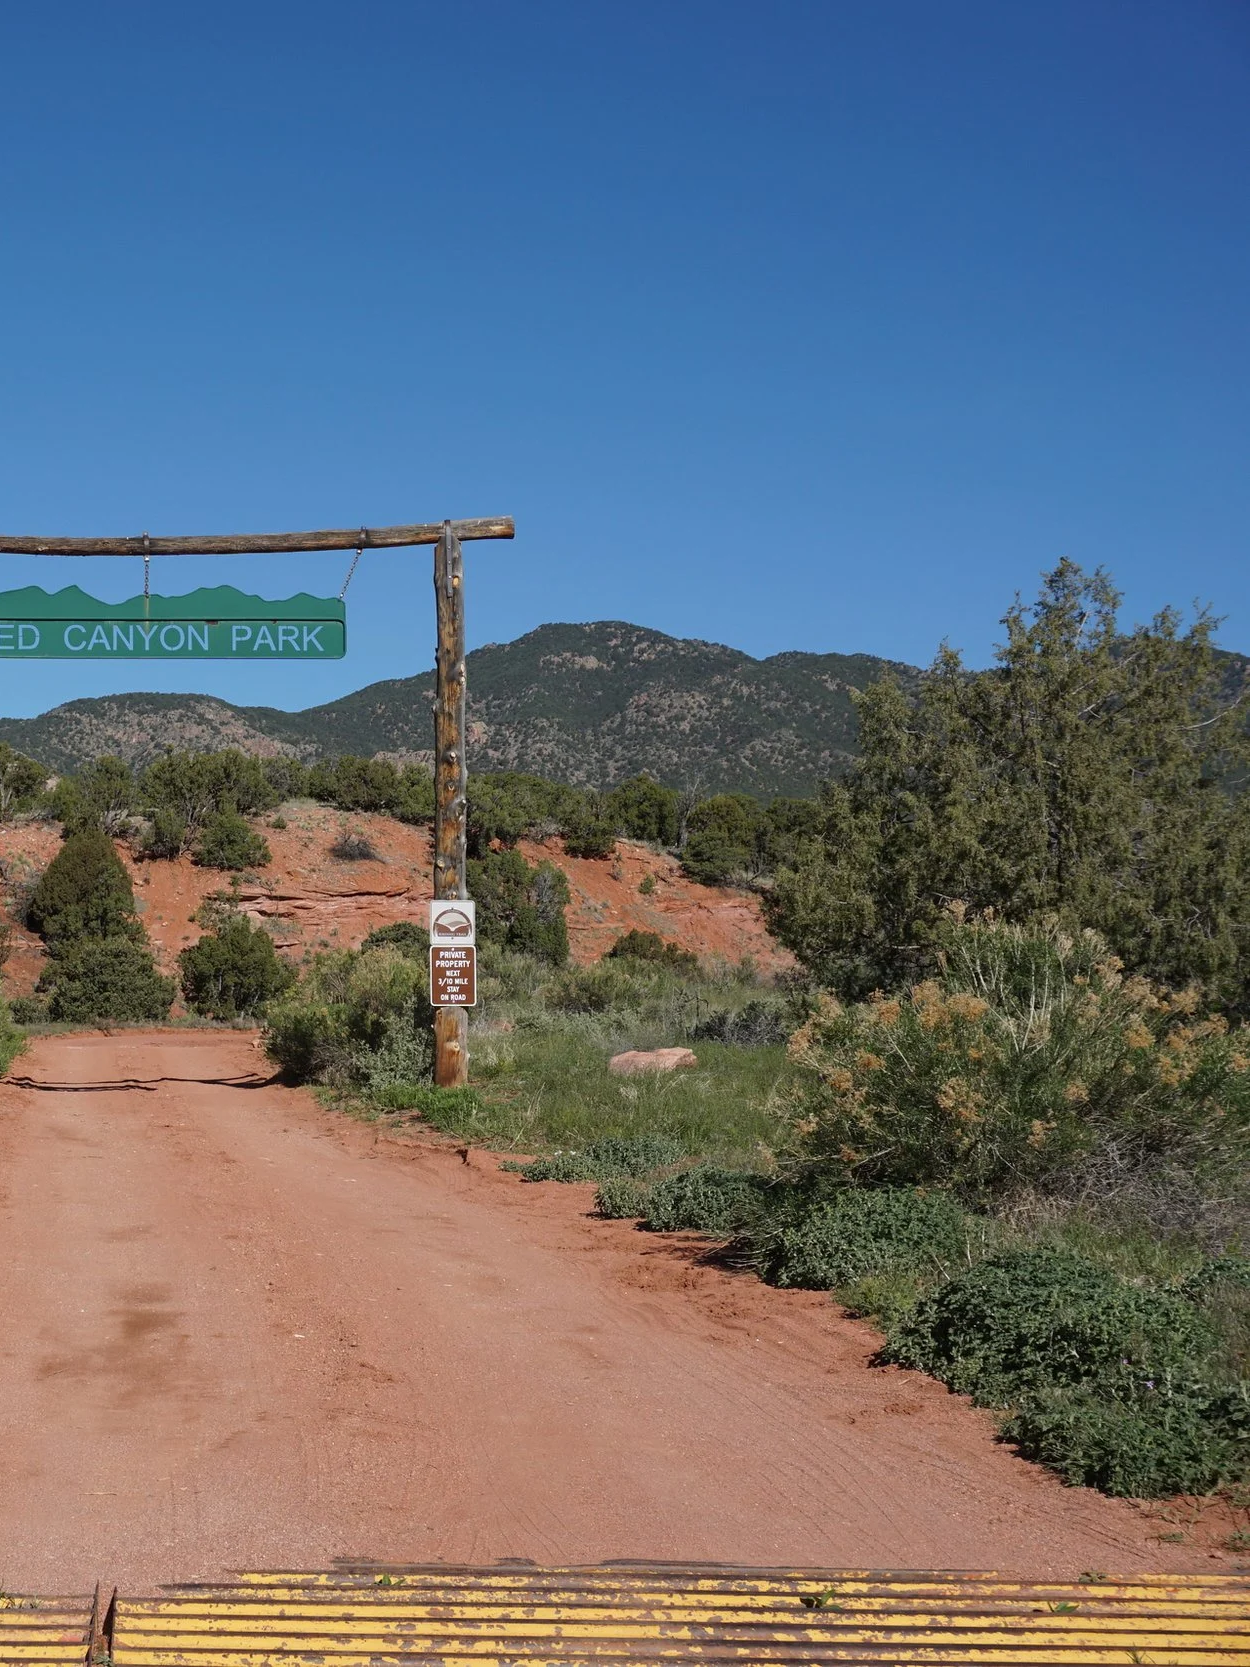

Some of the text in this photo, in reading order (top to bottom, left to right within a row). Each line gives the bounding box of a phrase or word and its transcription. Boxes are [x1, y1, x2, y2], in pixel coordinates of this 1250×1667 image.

[63, 624, 210, 651] CANYON
[231, 625, 324, 652] PARK
[440, 951, 466, 959] PRIVATE
[435, 960, 470, 968] PROPERTY
[438, 978, 453, 986] 3/10
